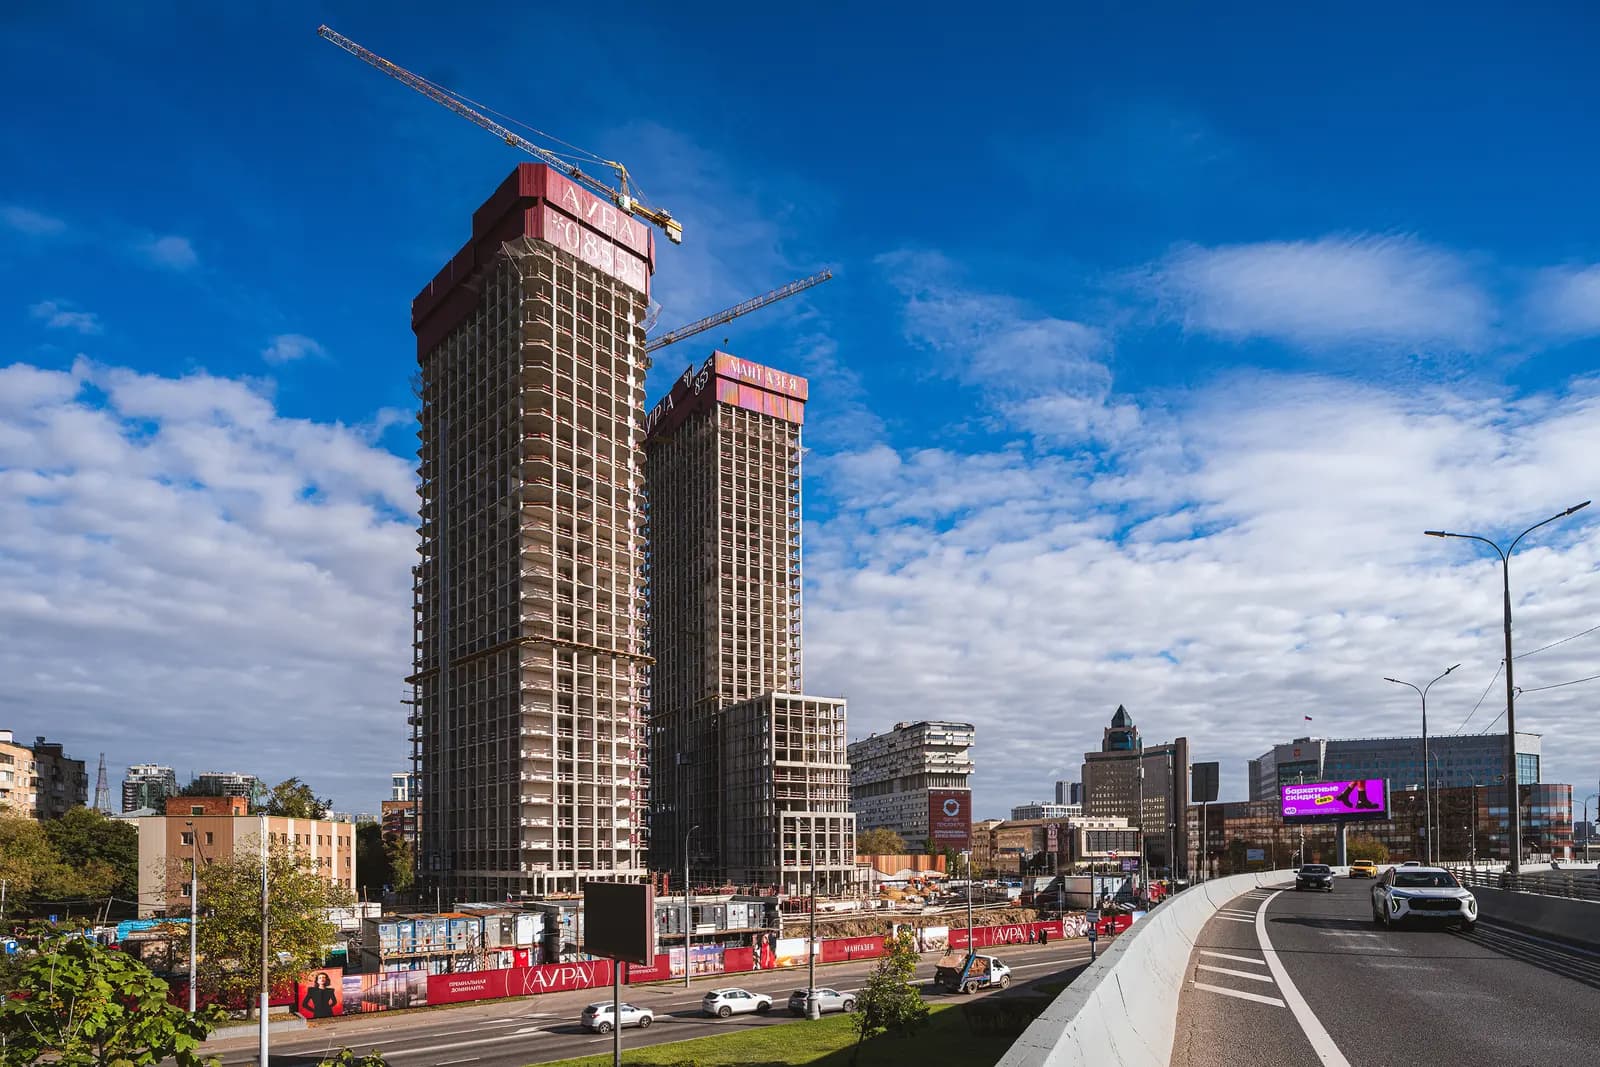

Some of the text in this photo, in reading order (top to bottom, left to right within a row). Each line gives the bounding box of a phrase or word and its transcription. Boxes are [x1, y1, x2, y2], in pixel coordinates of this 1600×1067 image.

[562, 186, 636, 244] АУРА
[731, 360, 796, 390] МАНГАЗЕЯ
[1285, 786, 1338, 795] бархатные
[996, 927, 1024, 941] АУРА
[531, 966, 588, 989] АУРА
